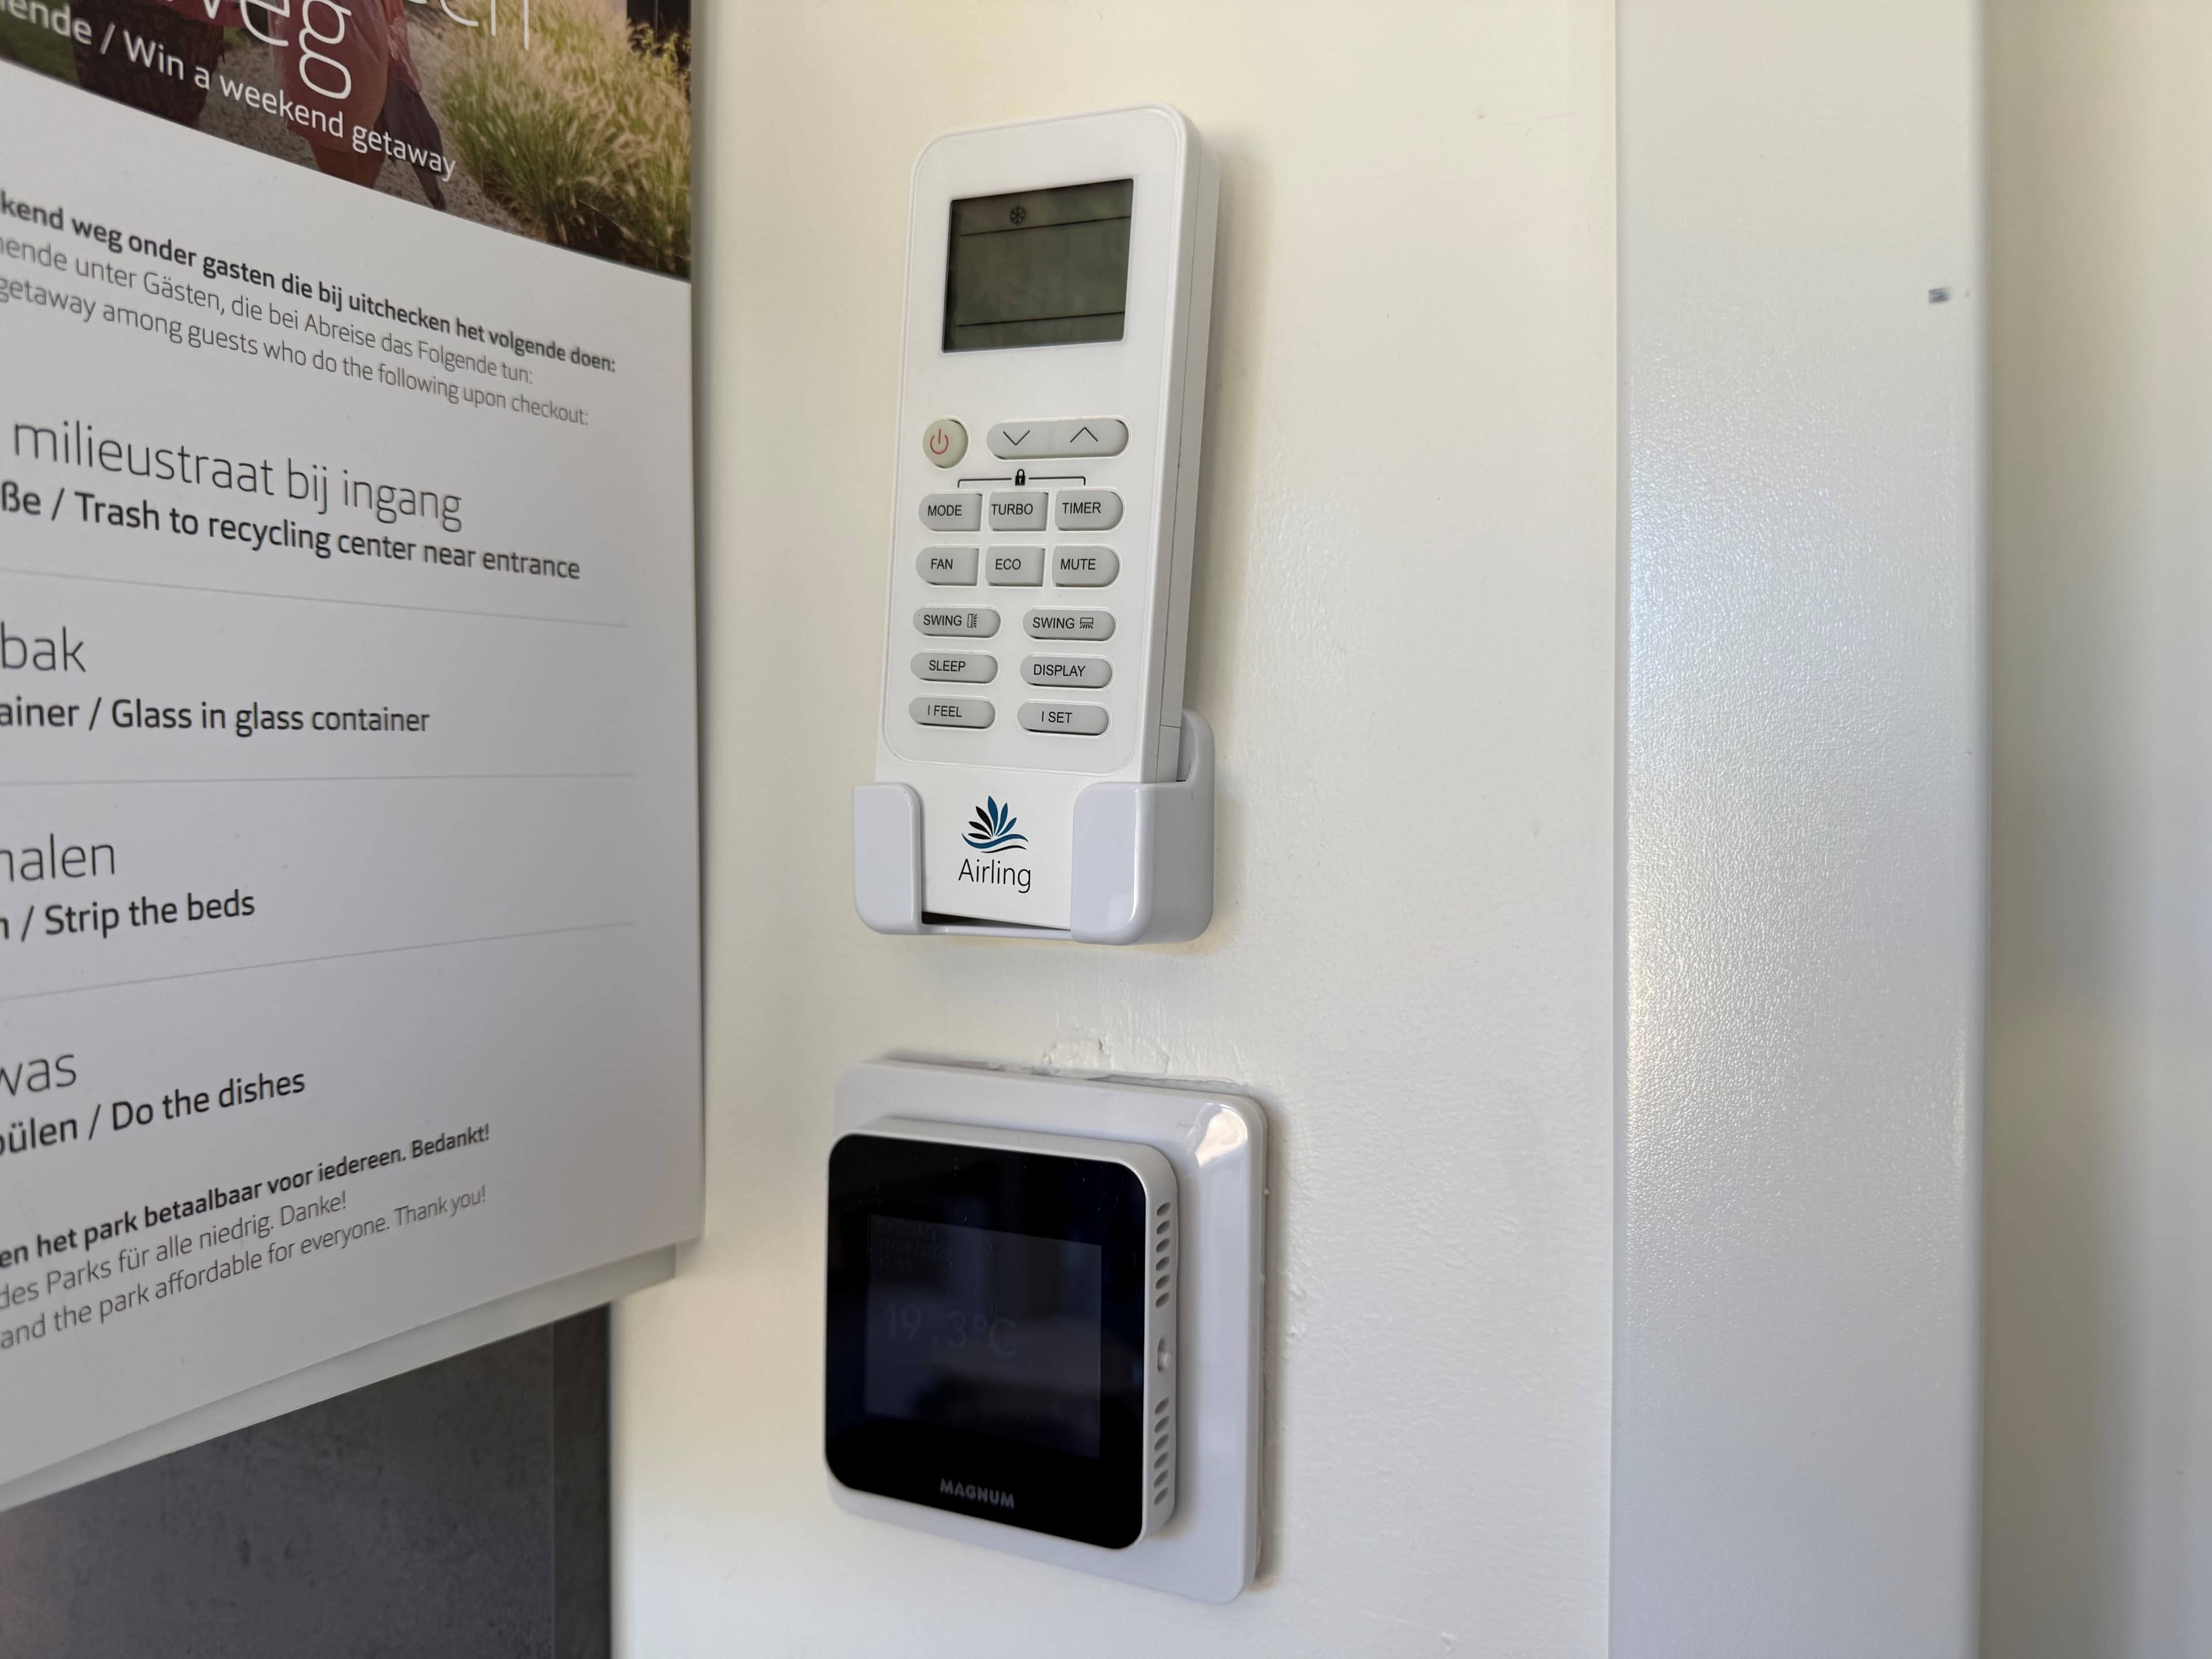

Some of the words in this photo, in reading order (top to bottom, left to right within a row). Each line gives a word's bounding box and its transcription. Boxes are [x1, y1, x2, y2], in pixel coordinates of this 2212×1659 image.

[99, 22, 115, 55] /
[123, 28, 184, 81] Win
[194, 65, 211, 90] a
[219, 74, 344, 138] weekend
[351, 124, 457, 183] getaway
[0, 188, 64, 231] kend
[70, 218, 123, 254] weg
[128, 234, 197, 267] onder
[203, 256, 275, 289] gasten
[282, 272, 313, 298] die
[319, 281, 342, 312] bij
[349, 293, 450, 334] uitchecken
[455, 317, 485, 343] het
[487, 330, 566, 361] volgende
[569, 346, 615, 373] doen:
[75, 258, 137, 289] unter
[143, 271, 225, 315] Gästen,
[232, 295, 262, 321] die
[270, 302, 298, 330] bei
[304, 314, 376, 348] Abreise
[381, 332, 412, 357] das
[418, 340, 497, 376] Folgende
[501, 362, 532, 384] tun:
[103, 304, 183, 344] among
[188, 325, 257, 355] guests
[263, 340, 306, 366] who
[312, 350, 336, 372] do
[342, 356, 373, 380] the
[378, 363, 459, 404] following
[463, 388, 506, 409] upon
[512, 394, 588, 425] checkout:
[14, 419, 275, 495] milieustraat
[288, 457, 327, 515] bij
[342, 469, 462, 533] ingang
[927, 505, 963, 517] MODE
[991, 503, 1033, 516] TURBO
[1062, 502, 1101, 514] TIMER
[51, 487, 65, 521] /
[74, 490, 160, 531] Trash
[169, 507, 199, 535] to
[209, 517, 331, 559] recycling
[337, 535, 416, 560] center
[423, 545, 476, 567] near
[482, 552, 580, 579] entrance
[931, 558, 953, 570] FAN
[995, 558, 1021, 570] ECO
[1060, 558, 1096, 570] MUTE
[923, 614, 962, 627] SWING
[1032, 616, 1075, 630] SWING
[0, 620, 86, 672] bak
[929, 660, 966, 672] SLEEP
[1033, 664, 1086, 677] DISPLAY
[88, 696, 102, 731] /
[112, 698, 192, 729] Glass
[201, 701, 226, 729] in
[234, 702, 304, 737] glass
[311, 706, 430, 732] container
[933, 704, 963, 718] FEEL
[1048, 711, 1073, 724] SET
[957, 858, 1031, 894] Airling
[21, 904, 35, 942] /
[44, 901, 120, 939] Strip
[128, 896, 177, 927] the
[187, 889, 255, 921] beds
[88, 1104, 101, 1141] /
[112, 1101, 154, 1131] Do
[162, 1089, 210, 1120] the
[218, 1073, 305, 1108] dishes
[0, 1245, 29, 1269] en
[36, 1229, 78, 1258] het
[84, 1211, 138, 1252] park
[144, 1183, 263, 1228] betaalbaar
[267, 1170, 313, 1195] voor
[318, 1149, 407, 1182] iedereen.
[411, 1123, 489, 1159] Bedankt!
[46, 1260, 112, 1295] Parks
[118, 1248, 150, 1273] für
[156, 1235, 192, 1262] alle
[200, 1215, 274, 1249] niedrig.
[280, 1191, 346, 1226] Danke!
[0, 1312, 46, 1349] and
[54, 1305, 92, 1332] the
[100, 1283, 149, 1324] park
[156, 1251, 262, 1299] affordable
[268, 1243, 295, 1264] for
[300, 1218, 389, 1255] everyone.
[393, 1196, 448, 1226] Thank
[450, 1185, 485, 1217] you!
[940, 1478, 1014, 1509] MAGNUM
